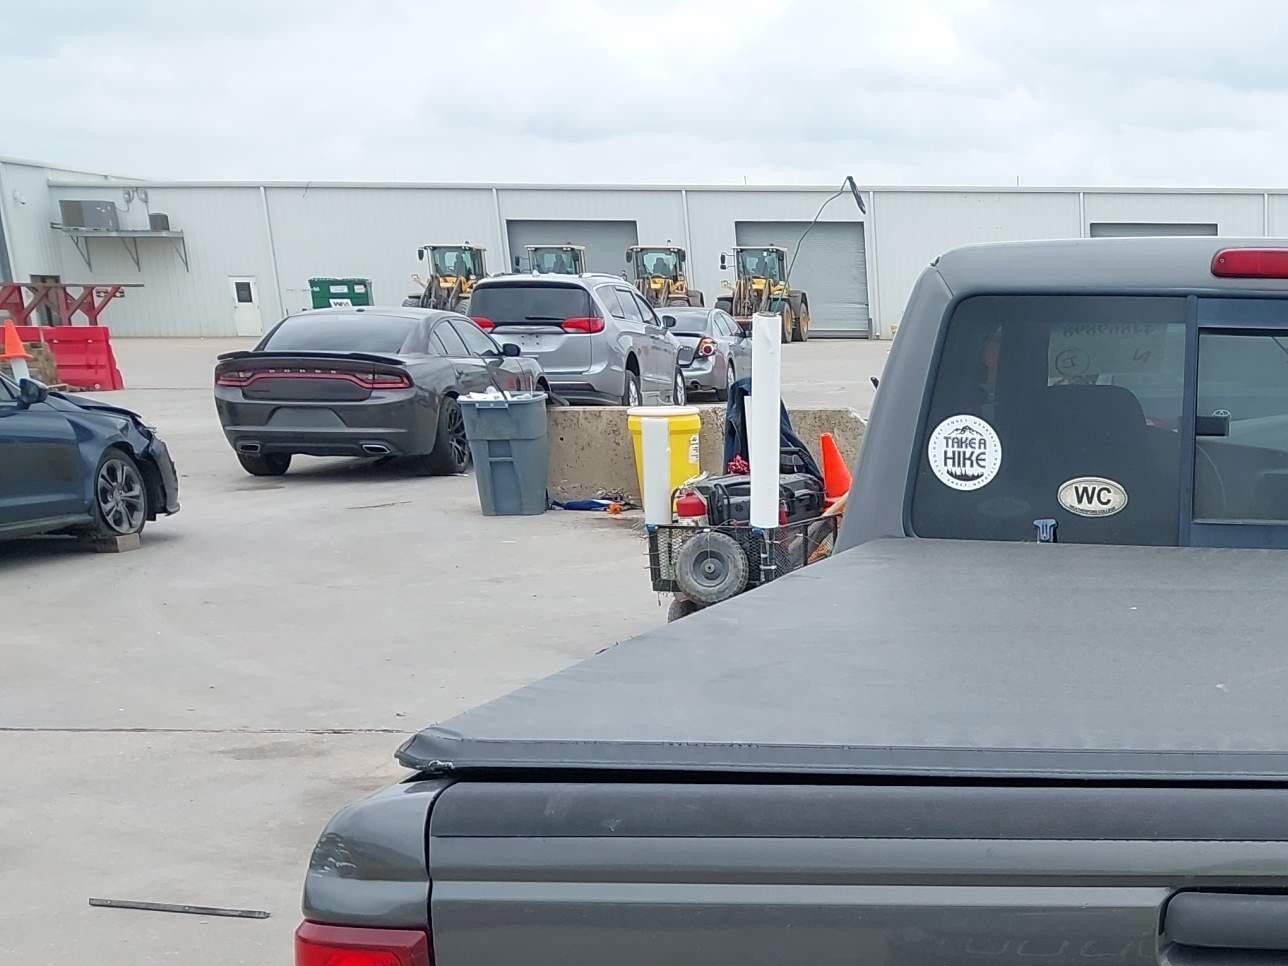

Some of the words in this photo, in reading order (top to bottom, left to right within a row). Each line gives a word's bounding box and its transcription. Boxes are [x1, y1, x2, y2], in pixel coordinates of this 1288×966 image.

[944, 436, 976, 449] TAKE
[978, 438, 987, 450] A
[944, 450, 987, 469] HIKE
[1074, 485, 1112, 506] WC
